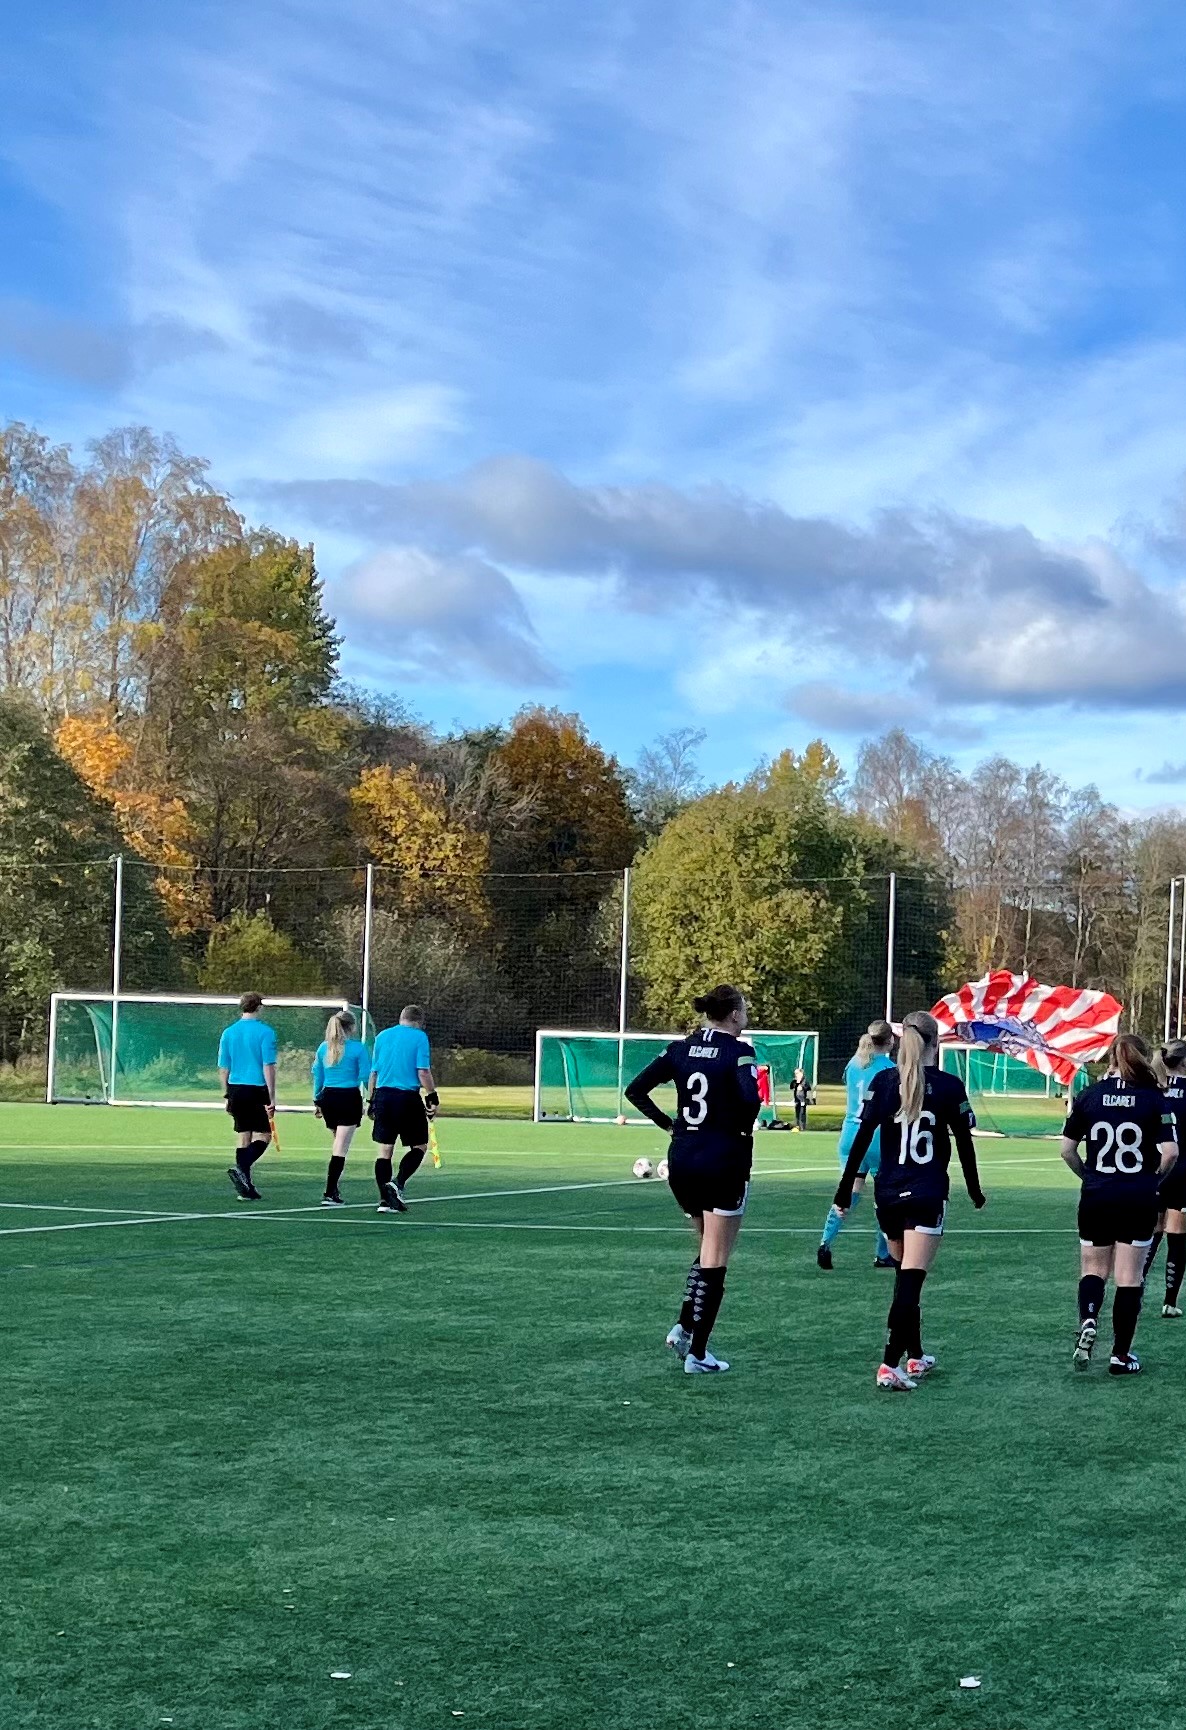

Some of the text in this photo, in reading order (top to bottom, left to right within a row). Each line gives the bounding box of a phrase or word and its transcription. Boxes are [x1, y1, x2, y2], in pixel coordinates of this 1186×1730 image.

[682, 1071, 709, 1125] 3
[893, 1110, 936, 1165] 16
[1090, 1120, 1143, 1174] 28
